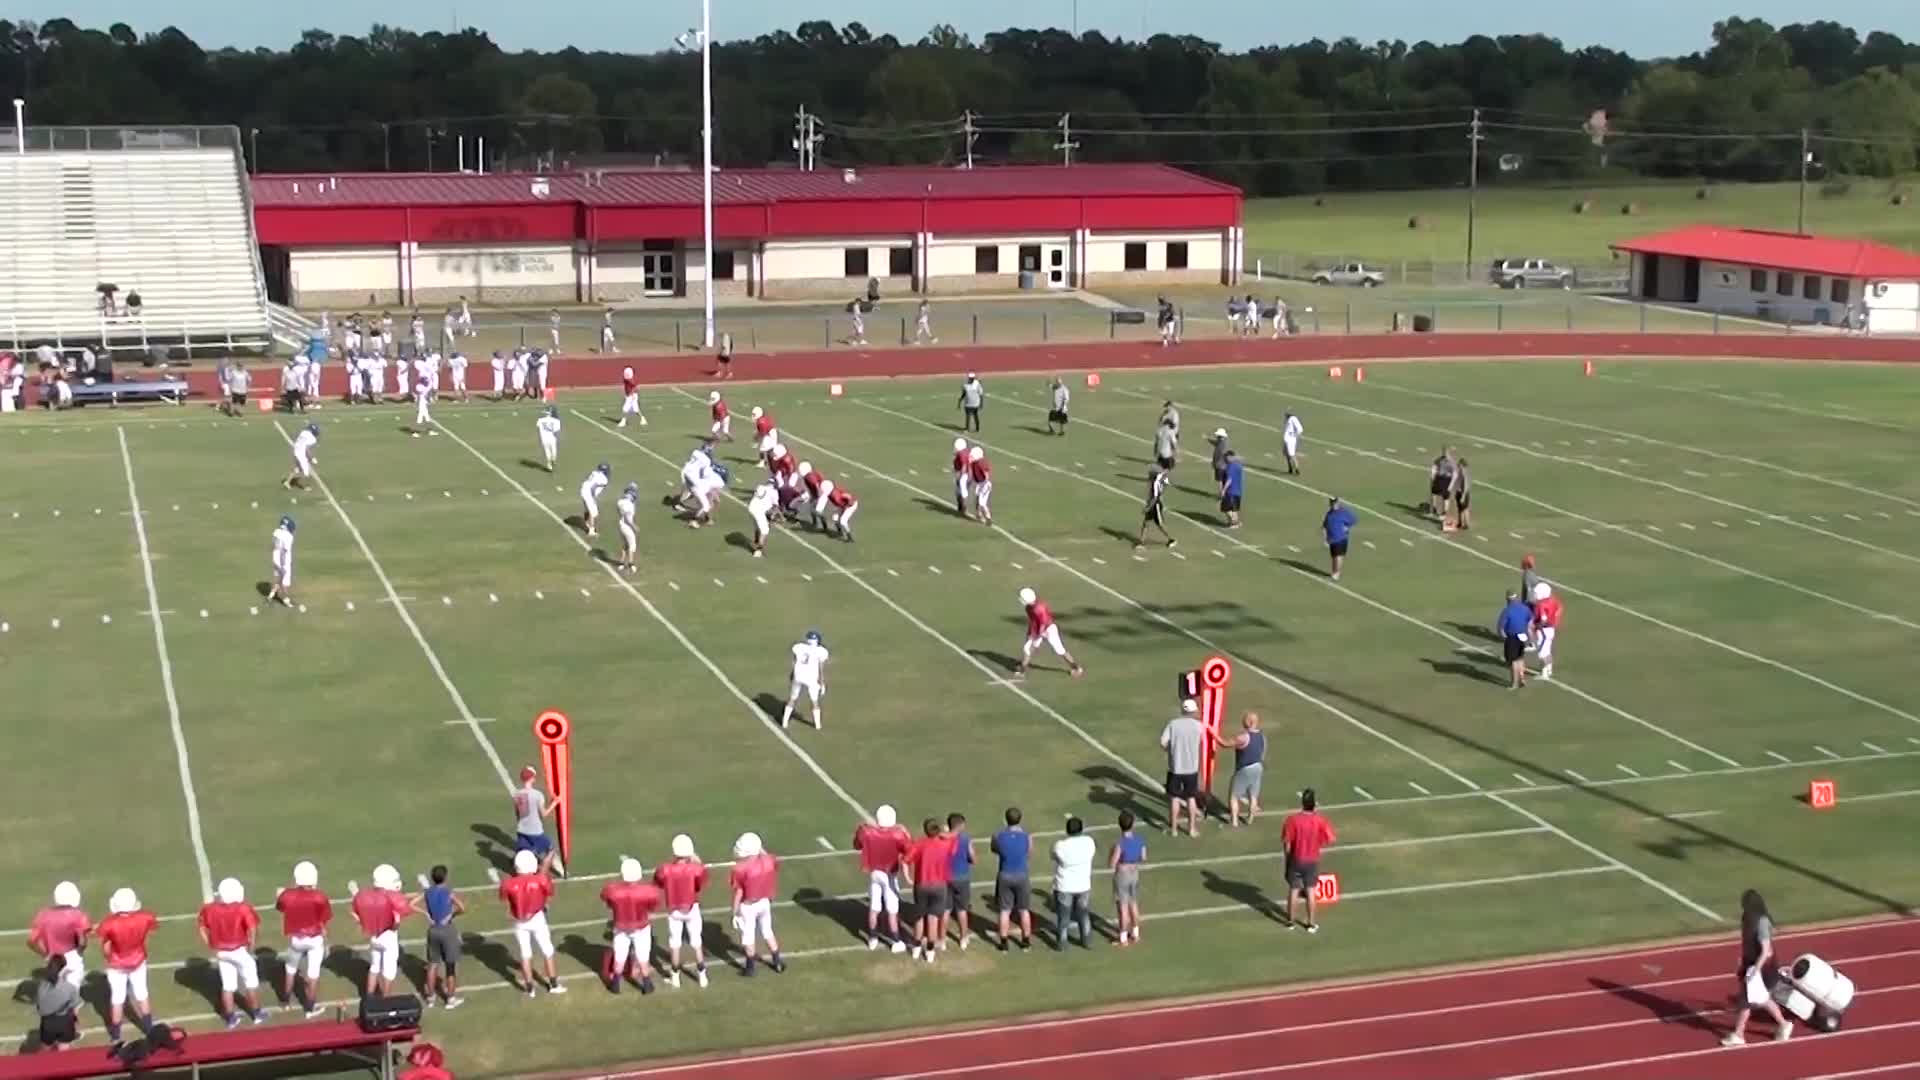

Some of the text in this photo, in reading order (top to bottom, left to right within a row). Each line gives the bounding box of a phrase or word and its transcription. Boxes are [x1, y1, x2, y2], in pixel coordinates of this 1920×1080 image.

[1186, 671, 1196, 695] 1
[1815, 785, 1832, 804] 20
[1315, 879, 1334, 899] 30
